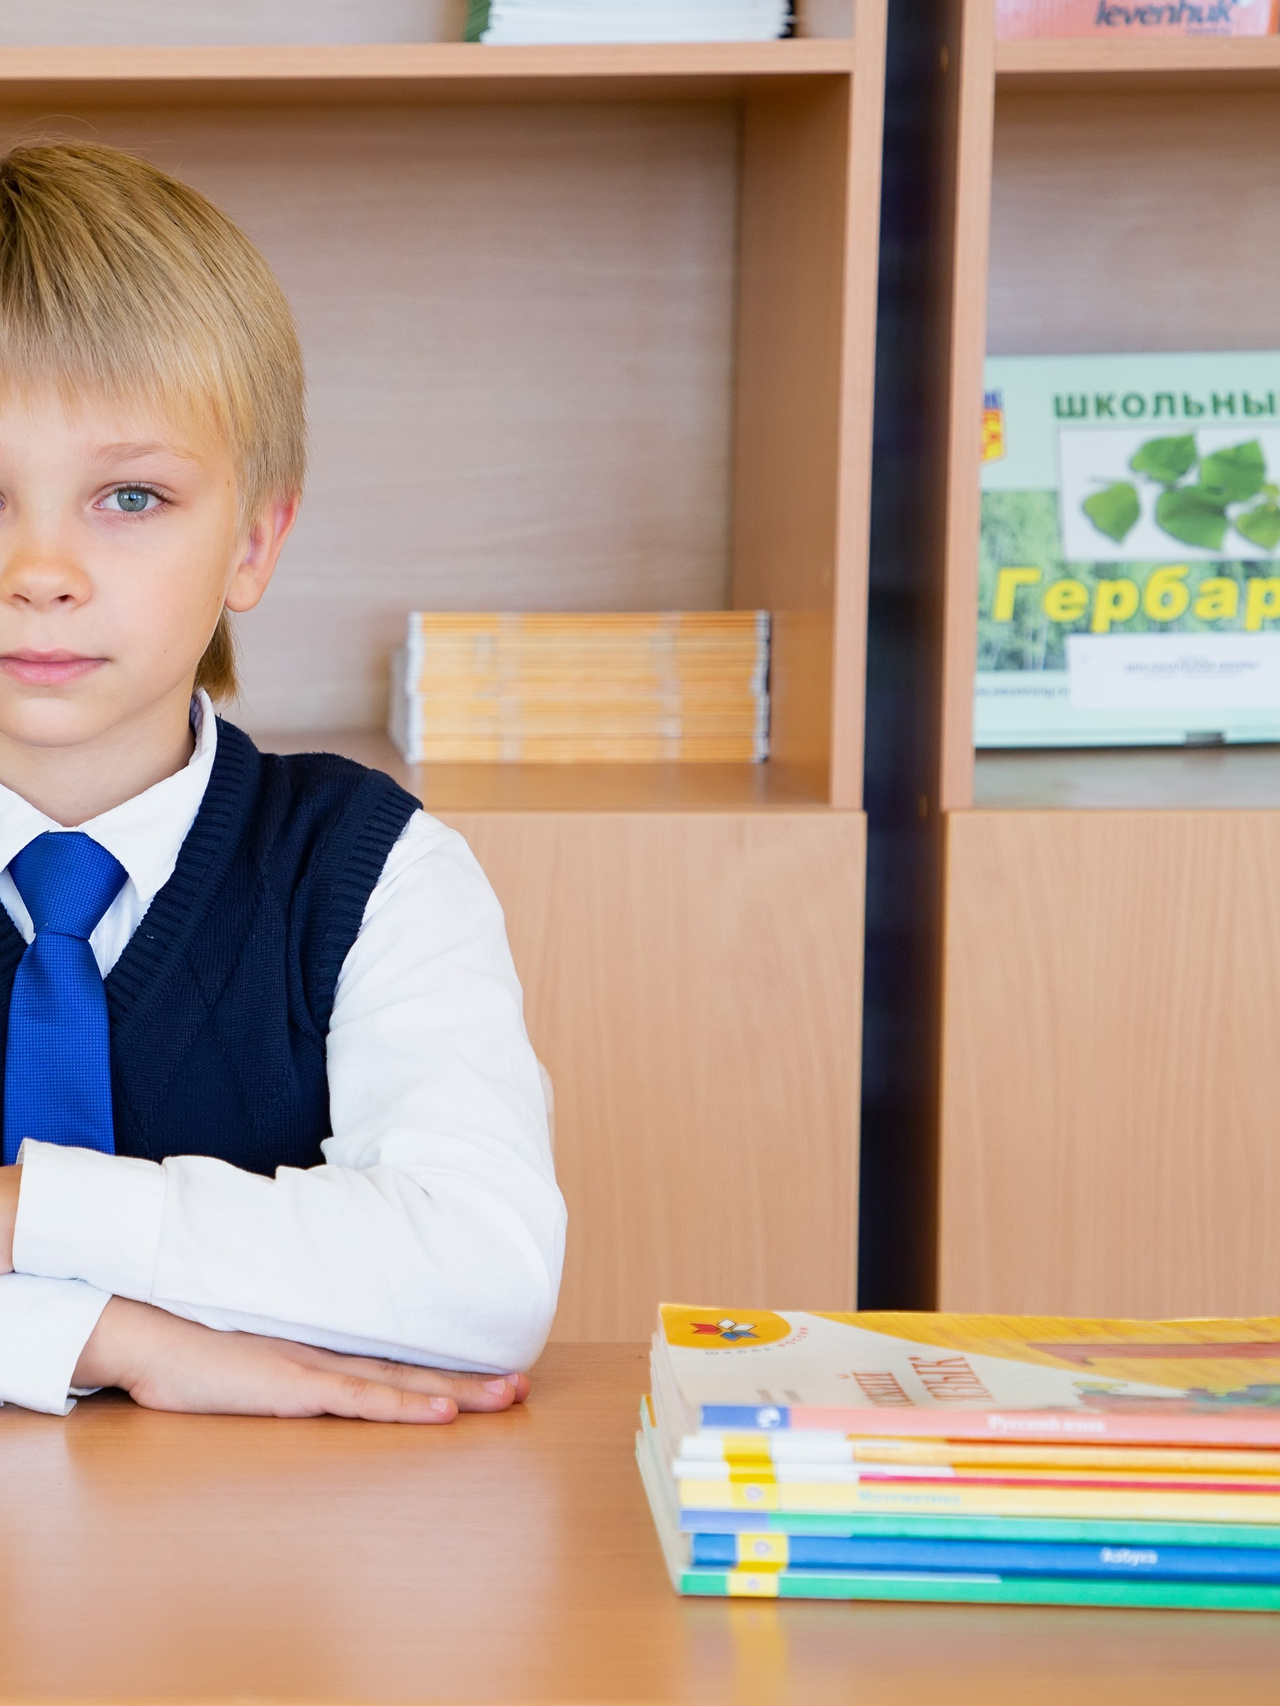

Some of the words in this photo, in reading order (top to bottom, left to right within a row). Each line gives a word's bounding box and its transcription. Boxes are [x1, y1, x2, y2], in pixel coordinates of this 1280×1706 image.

[1095, 0, 1231, 25] levenhuk
[1053, 391, 1275, 419] ШКОЛЬНЫ
[993, 565, 1280, 632] Гербар
